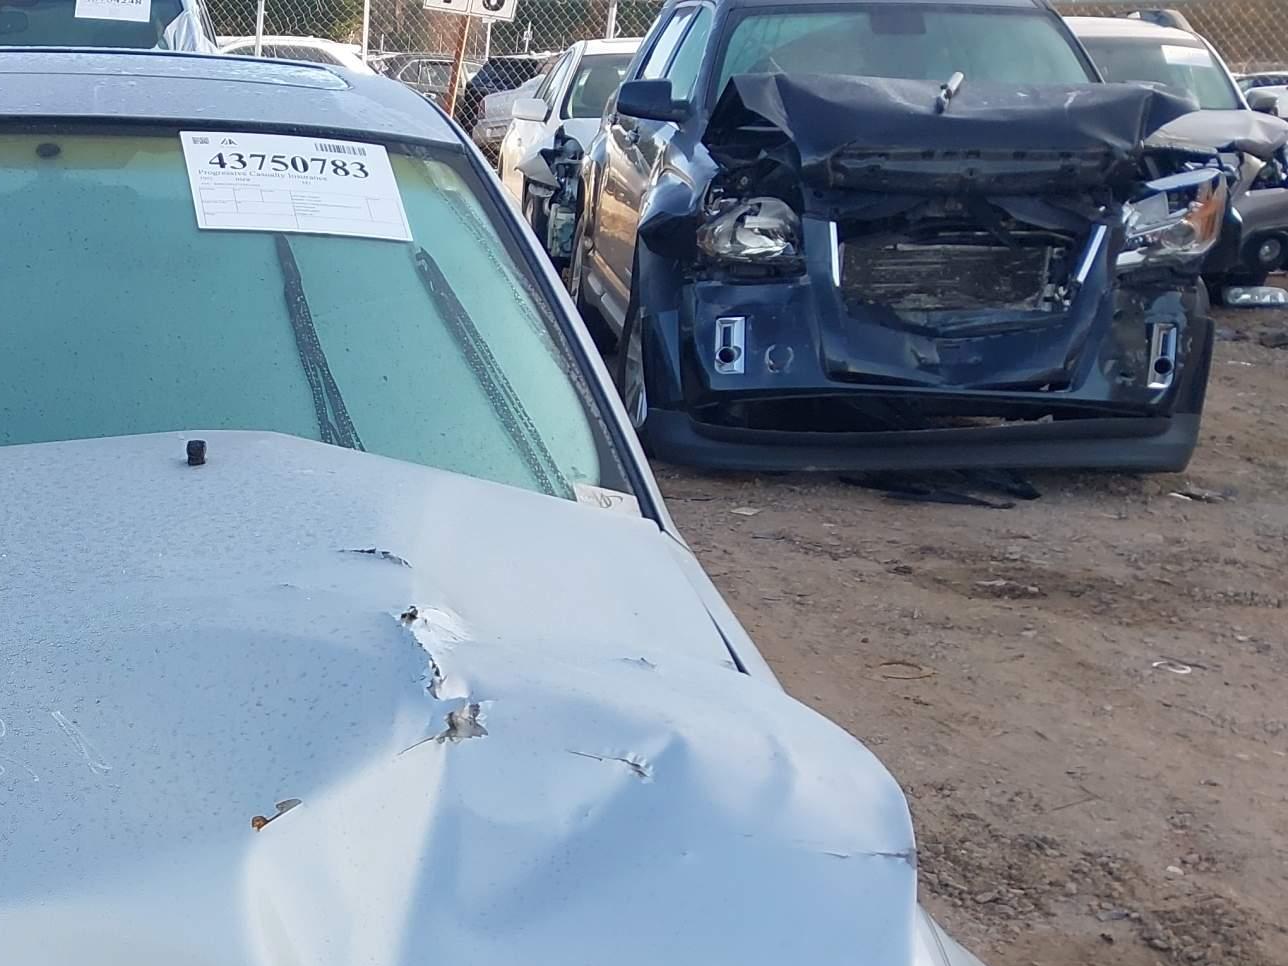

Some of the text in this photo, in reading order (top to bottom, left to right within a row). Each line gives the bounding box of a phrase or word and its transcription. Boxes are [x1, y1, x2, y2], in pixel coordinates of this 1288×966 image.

[198, 169, 247, 177] Progressive
[249, 171, 285, 179] Casualty
[208, 151, 370, 179] 43750783
